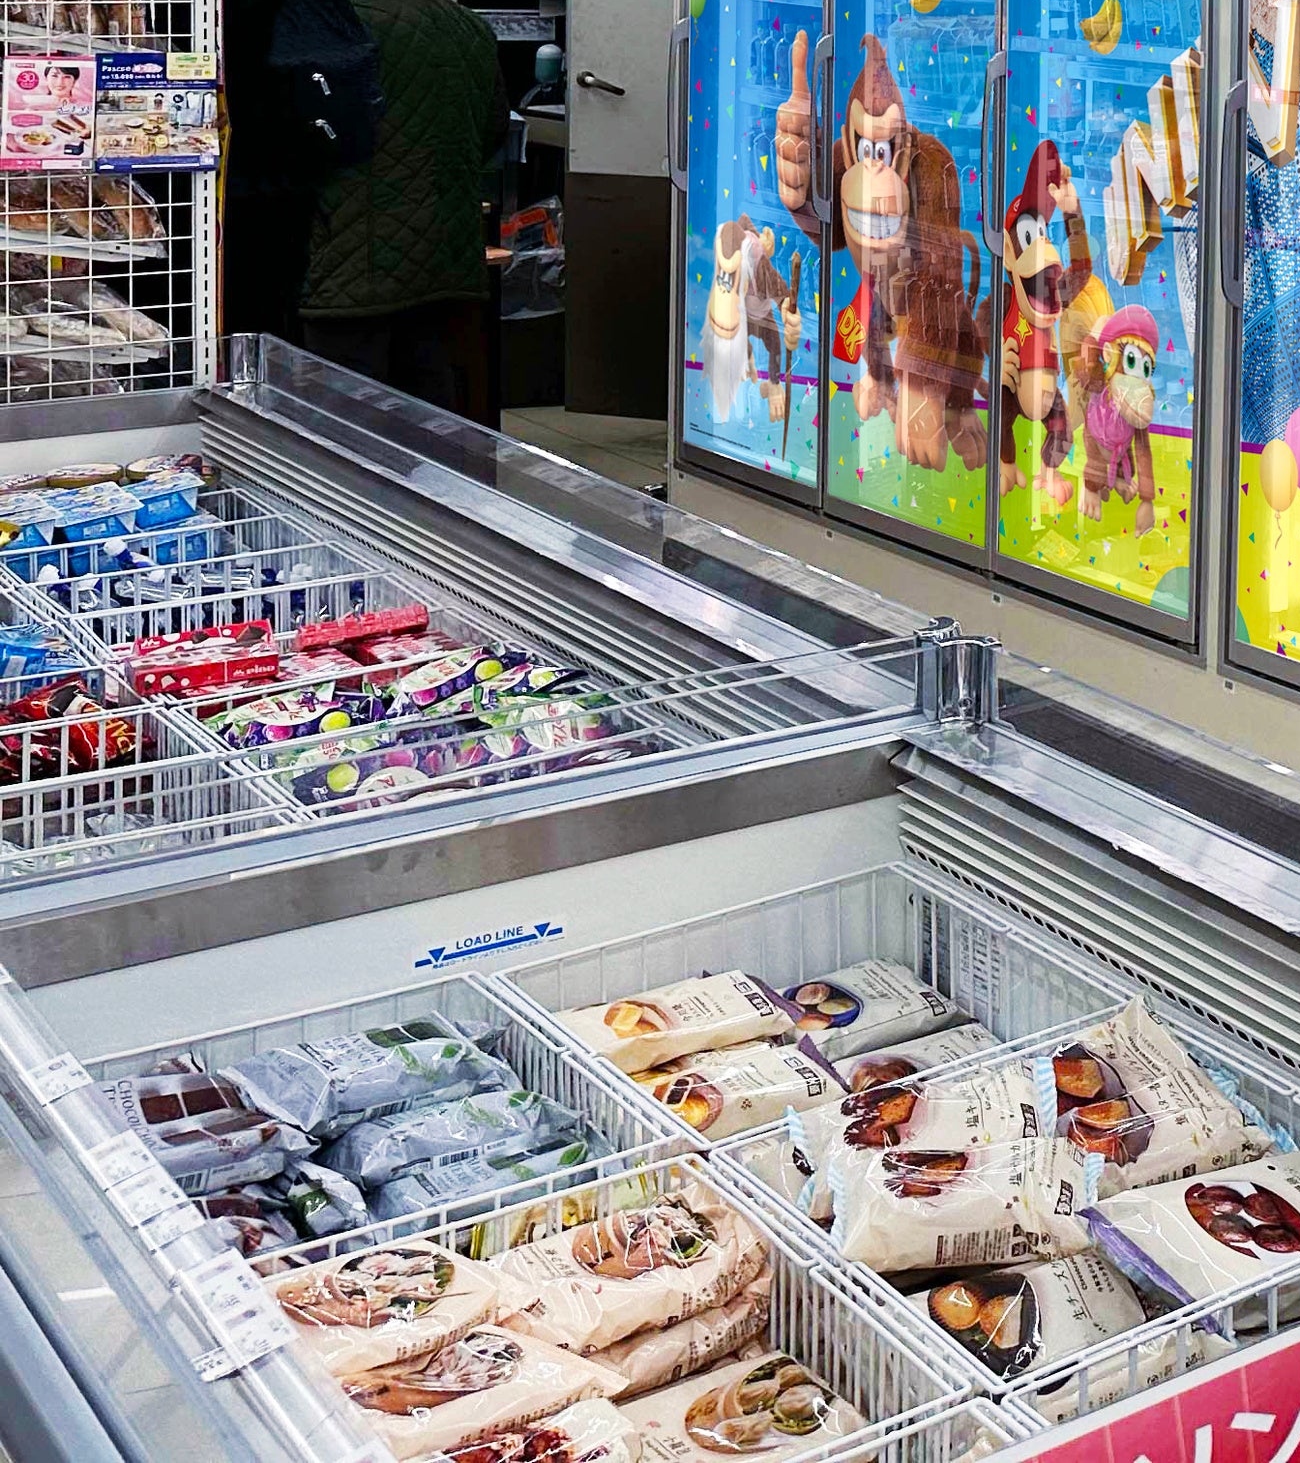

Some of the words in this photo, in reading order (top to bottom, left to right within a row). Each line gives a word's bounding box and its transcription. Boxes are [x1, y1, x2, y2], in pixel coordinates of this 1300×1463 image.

[837, 304, 867, 360] DK
[246, 664, 276, 675] pino
[456, 933, 492, 950] LOAD
[495, 926, 524, 941] LINE
